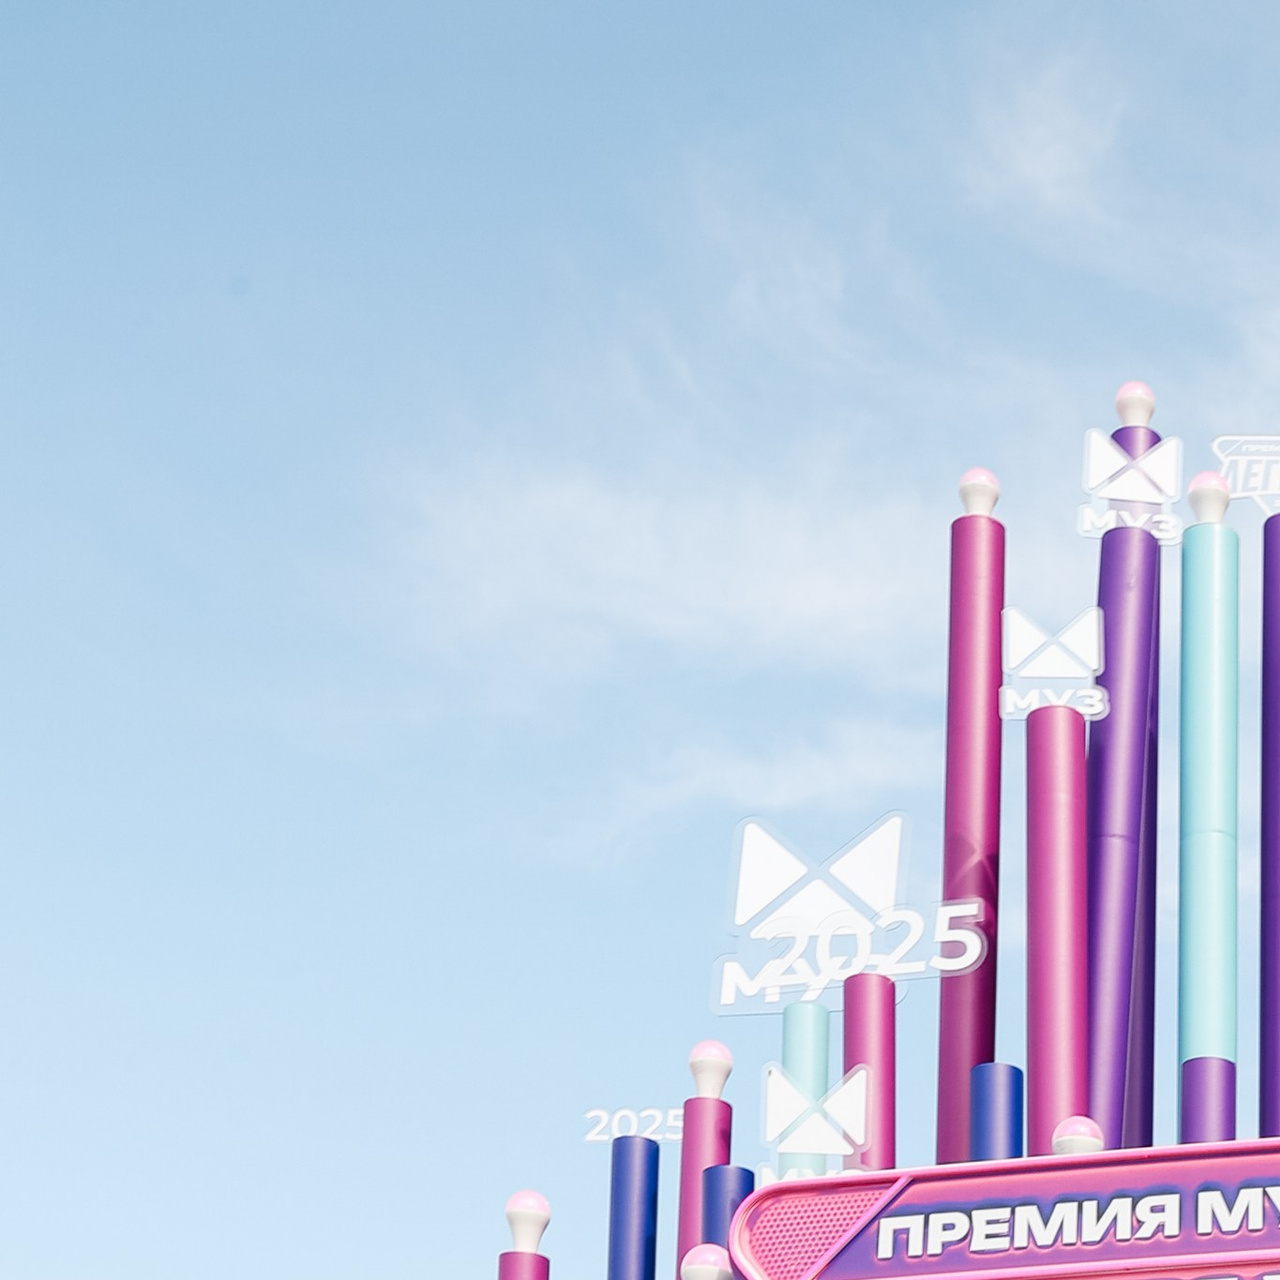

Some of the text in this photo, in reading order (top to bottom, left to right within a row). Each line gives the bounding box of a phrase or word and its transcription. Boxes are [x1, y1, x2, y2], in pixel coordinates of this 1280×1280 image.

[1005, 688, 1106, 716] МУЗ
[763, 903, 982, 986] 2025
[876, 1194, 1180, 1259] ПРЕМИЯ
